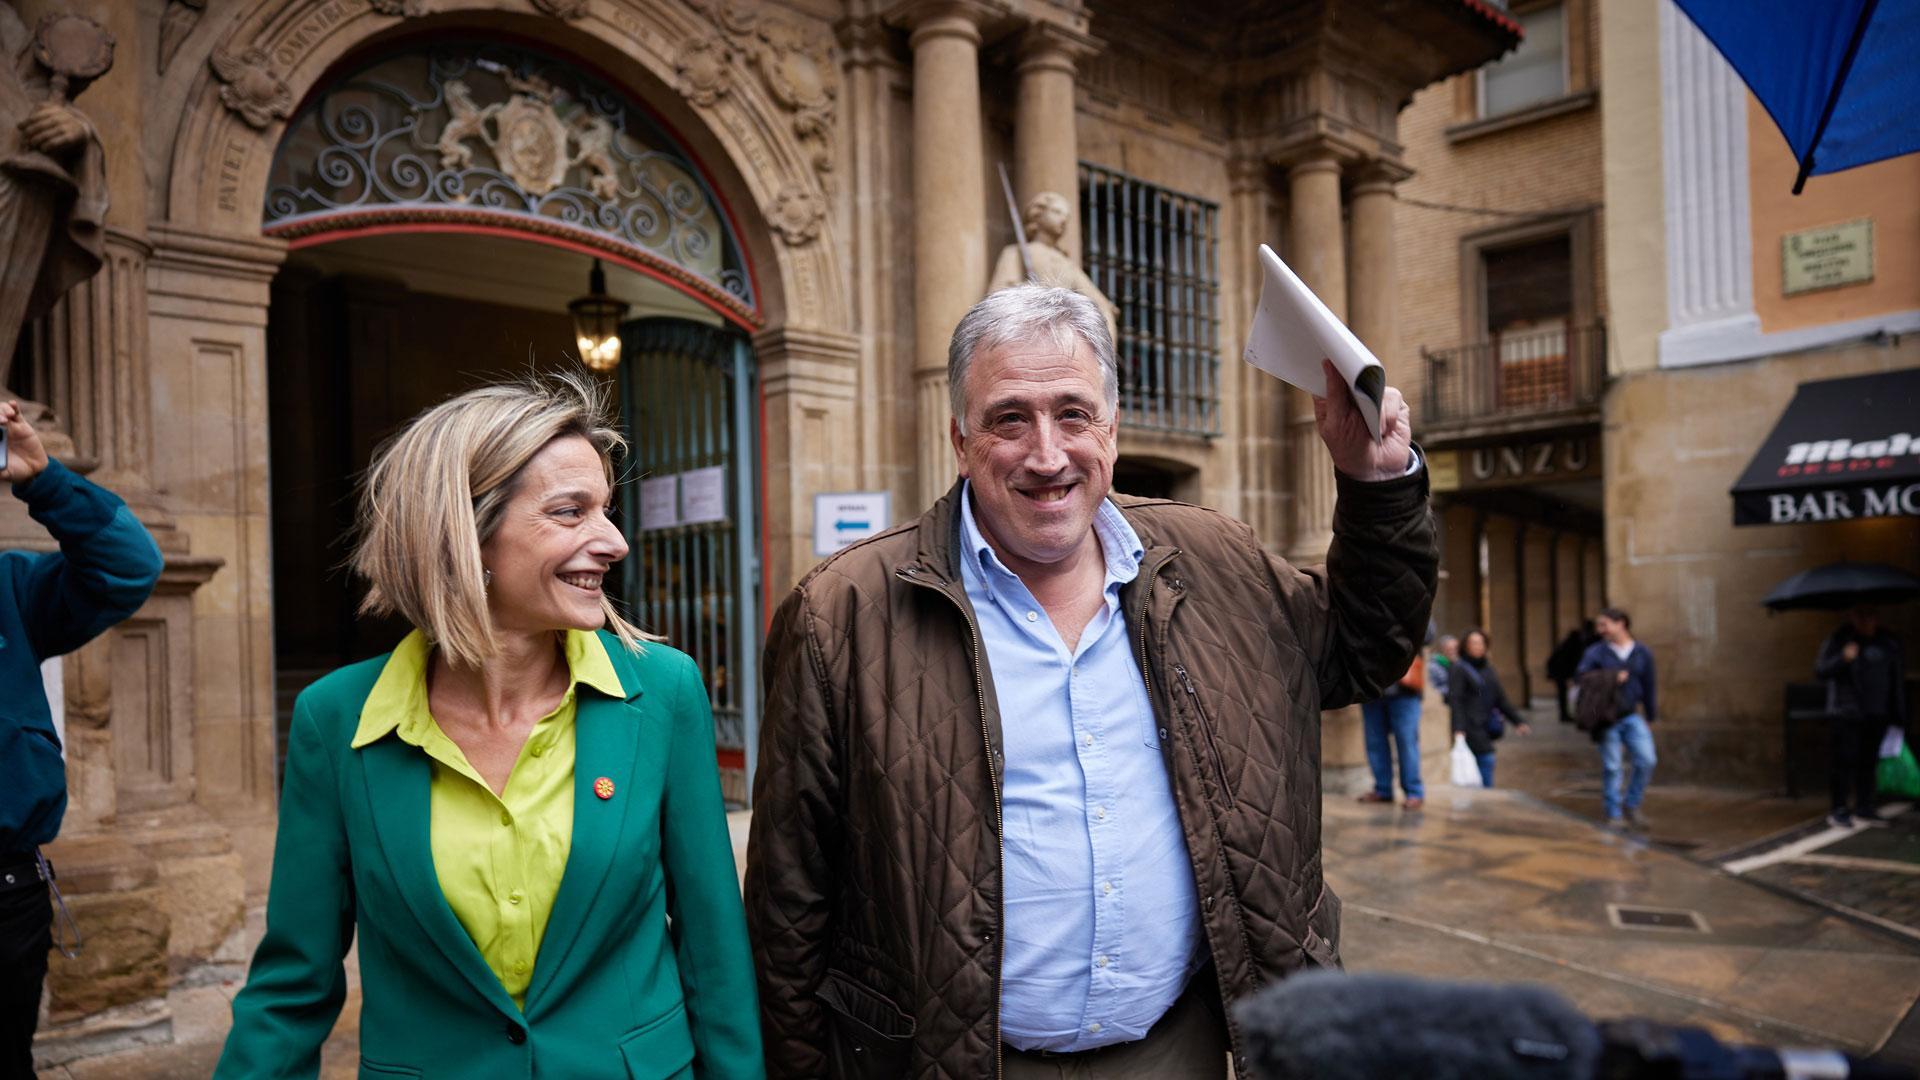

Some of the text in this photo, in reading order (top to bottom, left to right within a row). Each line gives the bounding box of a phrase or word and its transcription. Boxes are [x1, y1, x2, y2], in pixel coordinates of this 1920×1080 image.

[217, 138, 245, 213] PATET
[1472, 440, 1588, 479] UNZU
[1768, 491, 1854, 523] BAR
